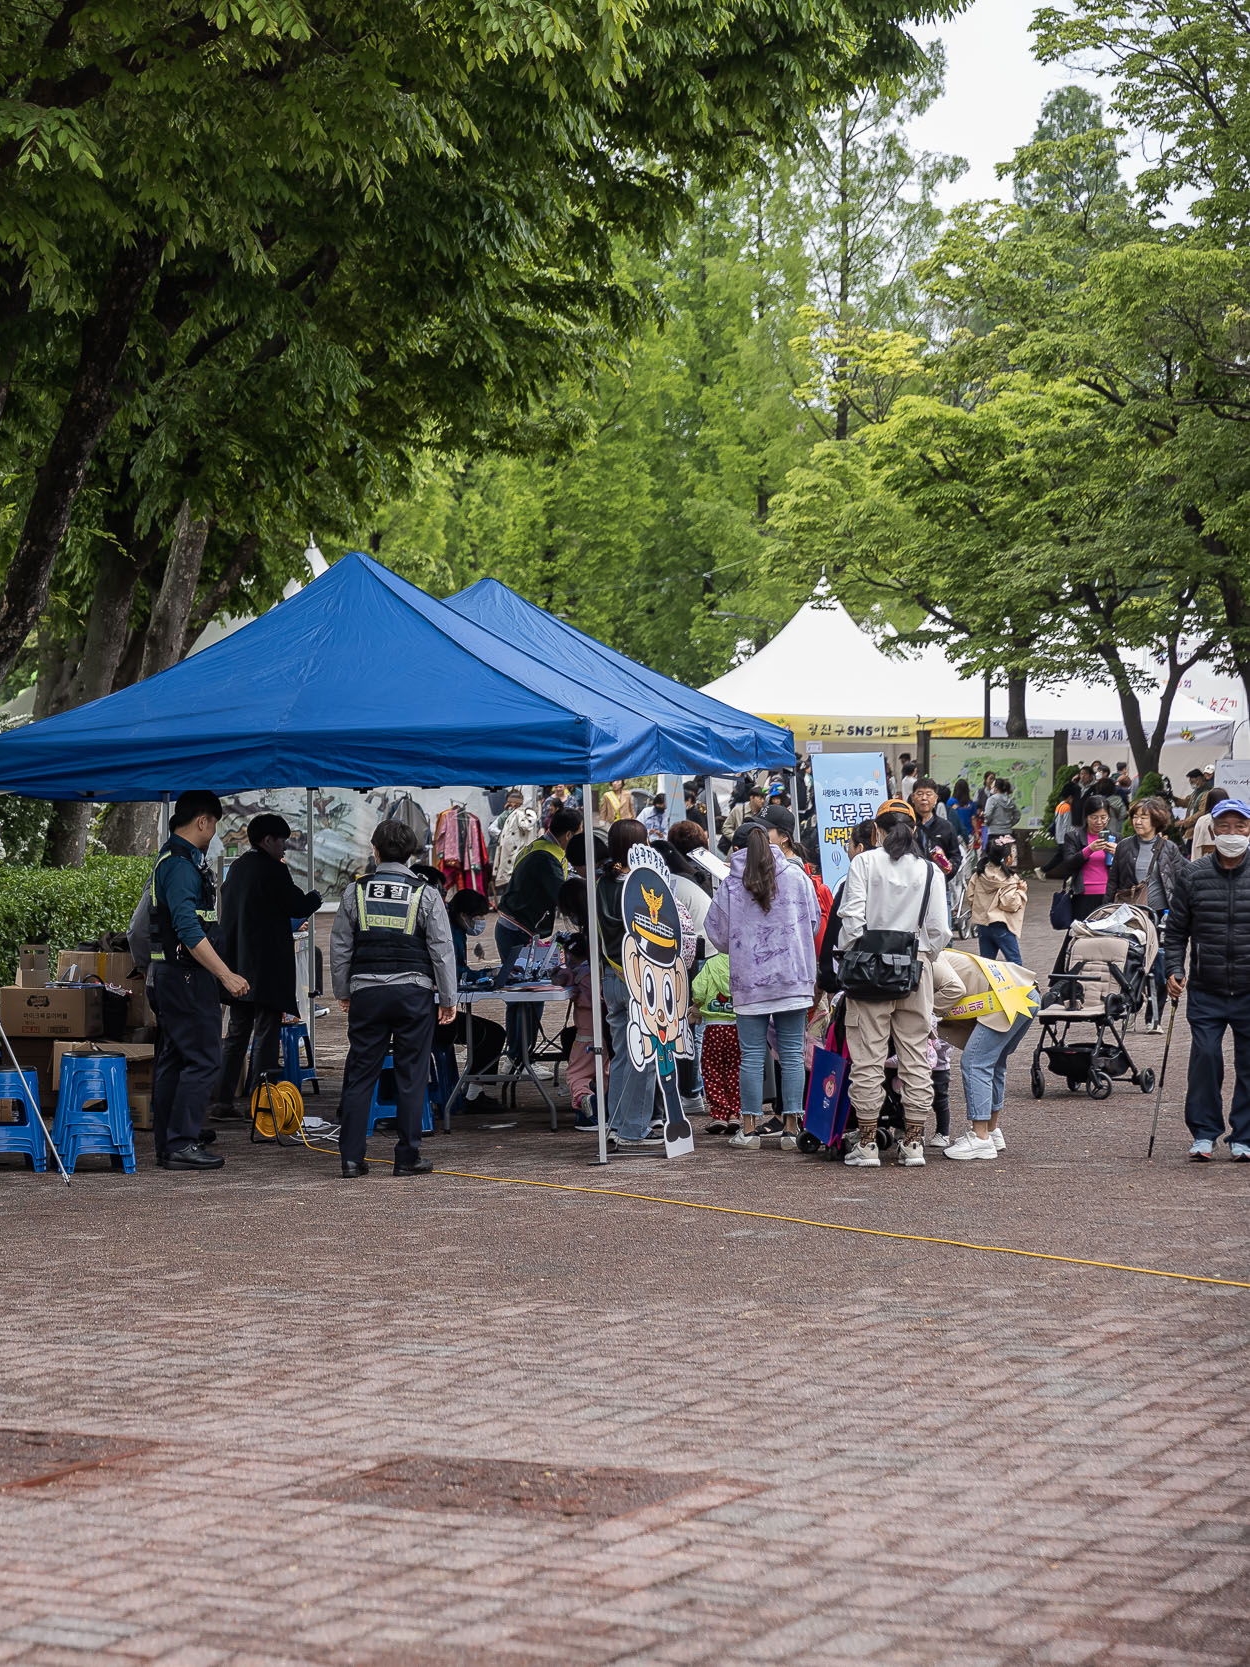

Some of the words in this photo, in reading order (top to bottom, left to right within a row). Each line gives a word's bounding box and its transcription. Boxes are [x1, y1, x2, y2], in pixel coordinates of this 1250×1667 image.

[807, 723, 911, 737] 광진구SNS이벤트
[822, 788, 840, 797] 사랑하는
[842, 788, 847, 796] 내
[849, 788, 863, 797] 가족을
[865, 787, 879, 796] 지키는
[830, 804, 856, 824] 지문
[824, 827, 852, 847] 사전
[373, 884, 404, 899] 경찰
[367, 916, 405, 927] POLICE
